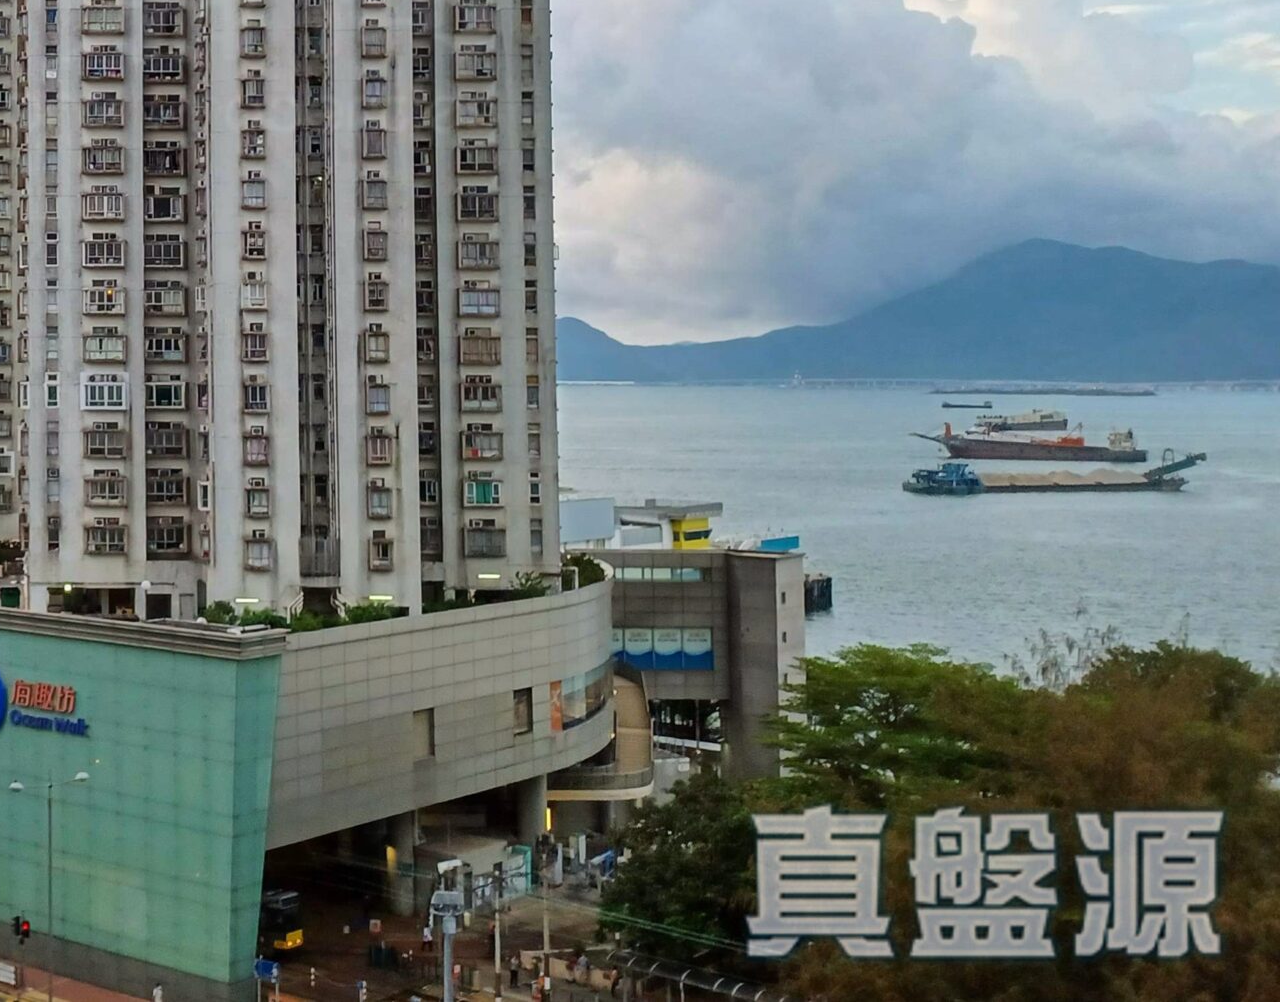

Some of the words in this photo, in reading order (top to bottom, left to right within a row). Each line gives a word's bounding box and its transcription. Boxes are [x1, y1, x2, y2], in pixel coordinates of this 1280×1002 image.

[10, 679, 76, 714] 海趣坊
[10, 709, 53, 730] Ocean
[54, 717, 89, 735] Walk
